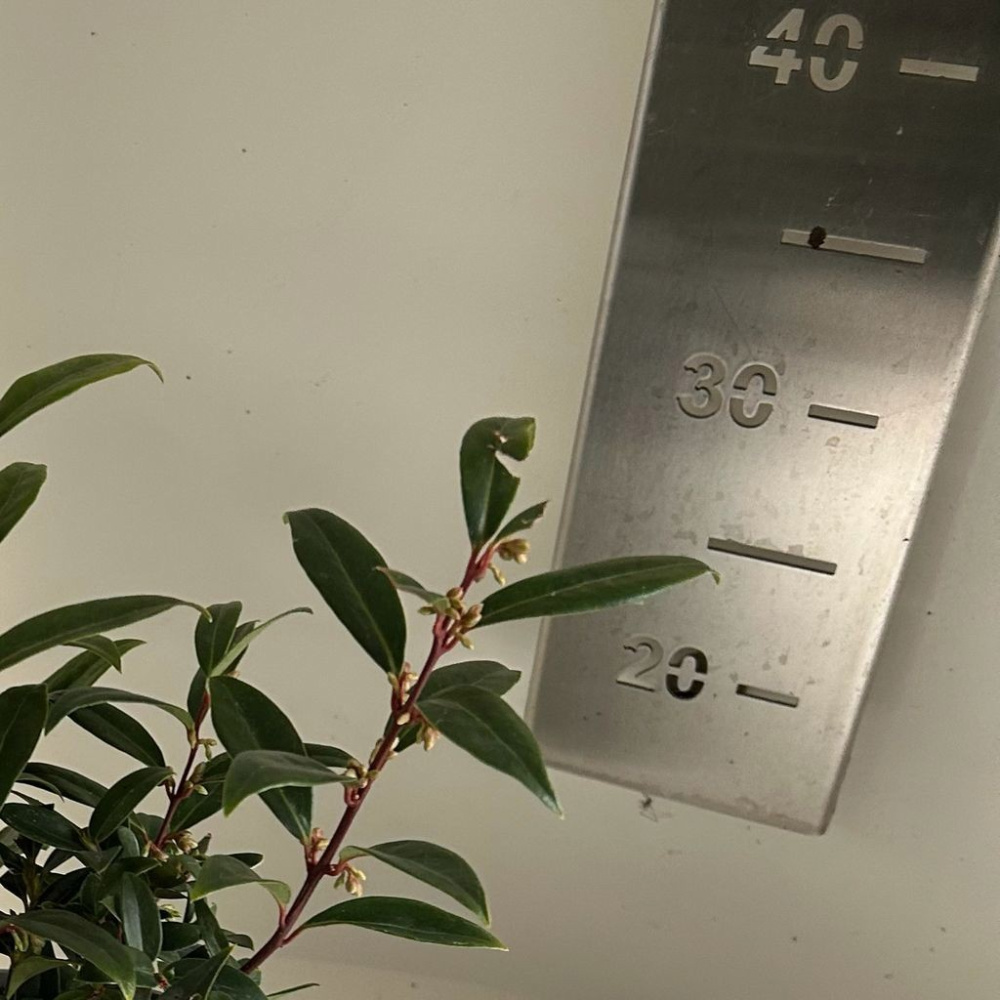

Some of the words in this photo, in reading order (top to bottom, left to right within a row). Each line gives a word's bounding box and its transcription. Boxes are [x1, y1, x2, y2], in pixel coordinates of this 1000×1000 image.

[748, 8, 864, 92] 40
[676, 351, 780, 429] 30
[616, 635, 709, 701] 20
